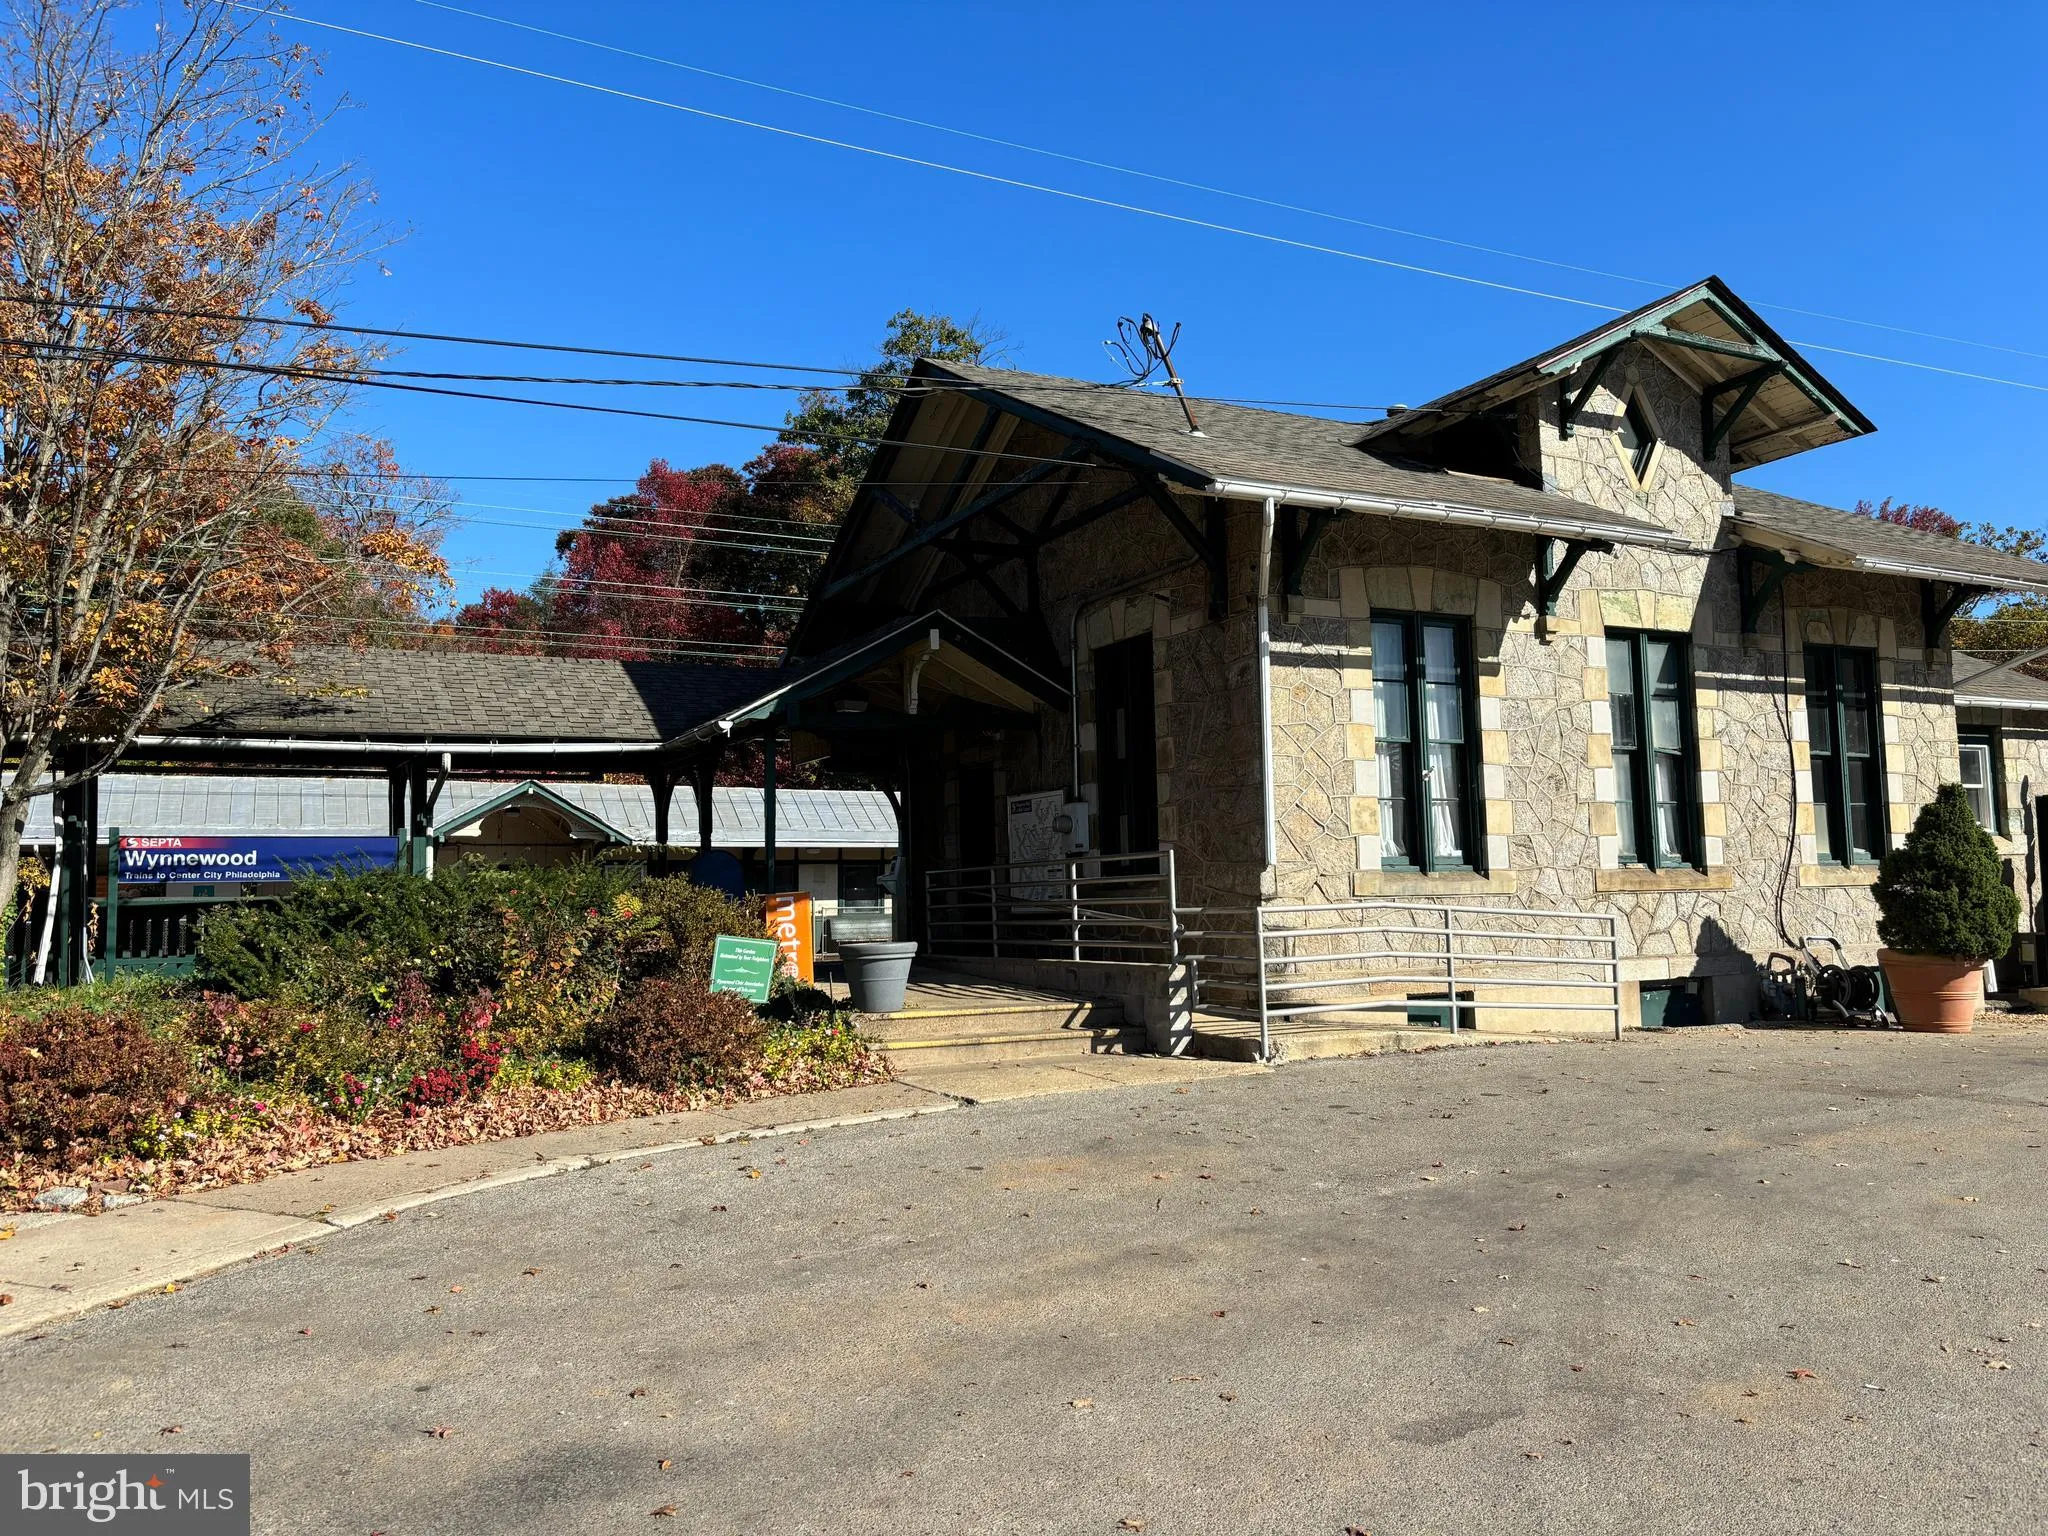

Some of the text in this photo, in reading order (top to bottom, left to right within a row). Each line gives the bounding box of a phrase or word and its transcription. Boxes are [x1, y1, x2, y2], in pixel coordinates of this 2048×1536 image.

[141, 837, 182, 848] SEPTA
[124, 849, 257, 870] Wynnewood
[124, 871, 281, 880] Trains to Center City Philadelphia
